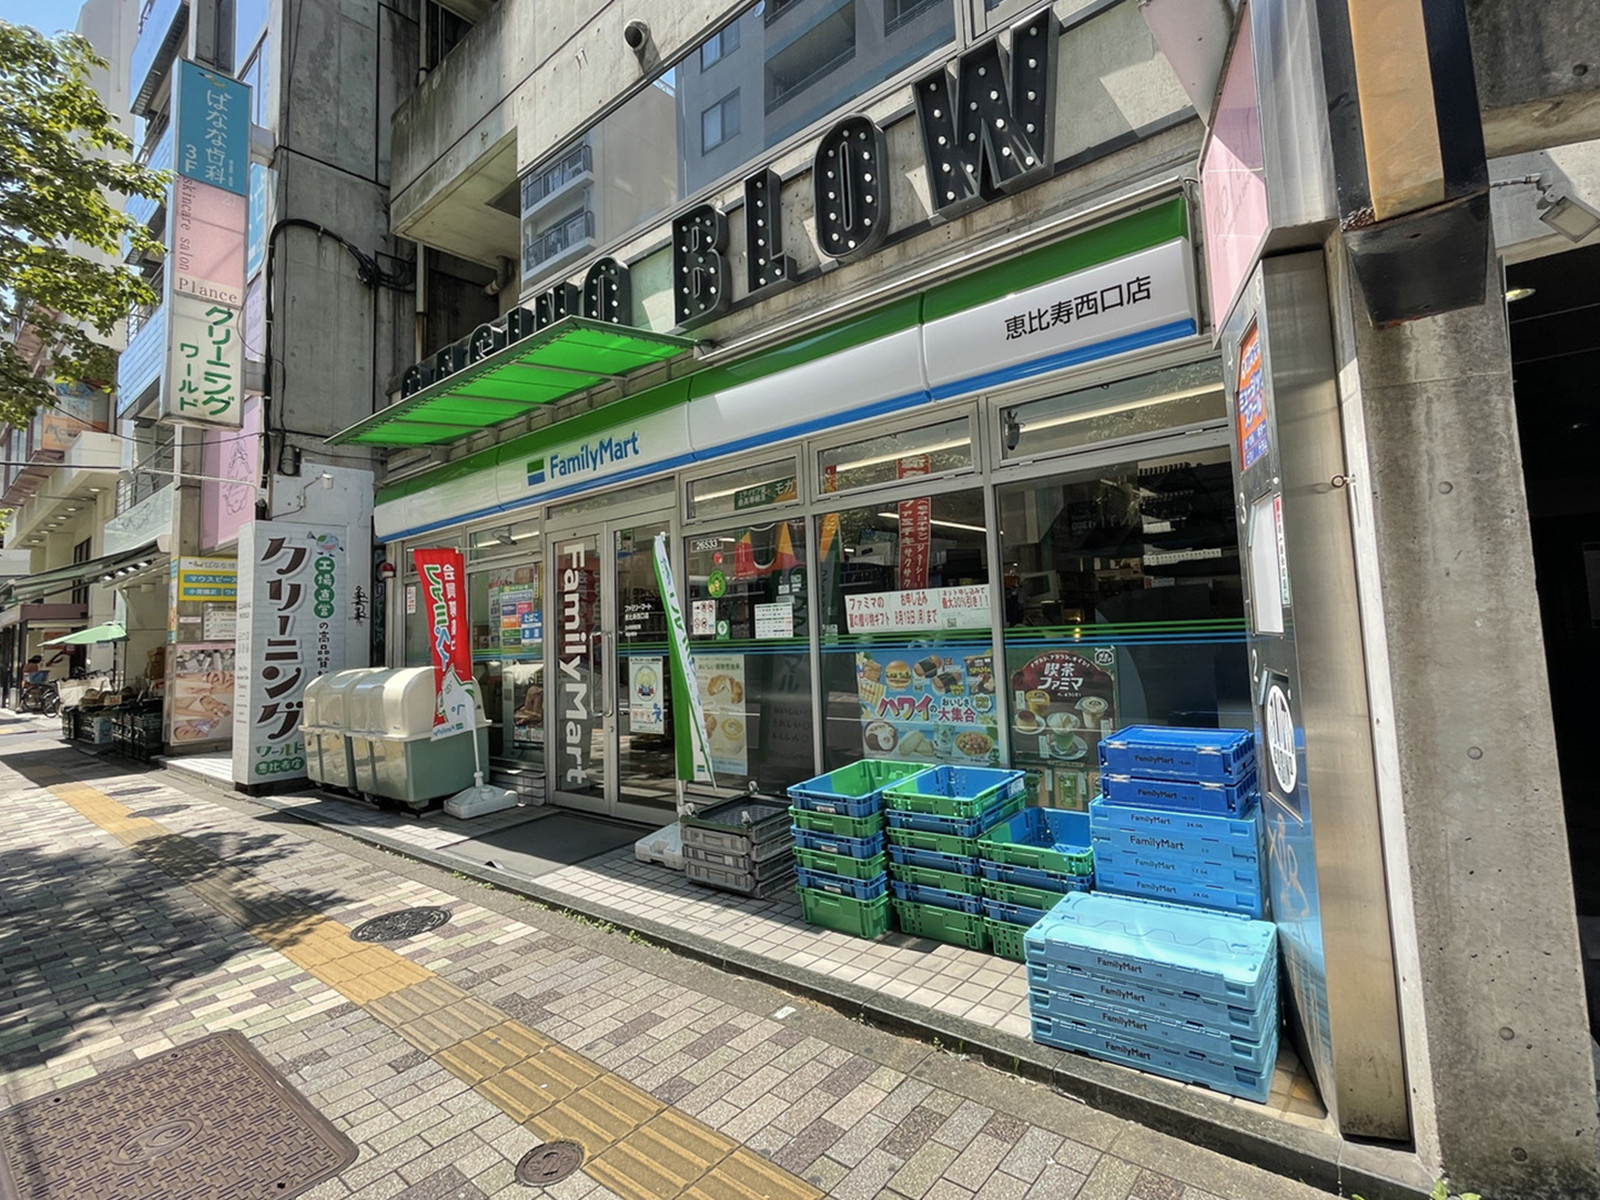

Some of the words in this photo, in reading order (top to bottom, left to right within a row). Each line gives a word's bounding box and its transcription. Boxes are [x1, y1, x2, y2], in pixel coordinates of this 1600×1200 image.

[204, 89, 232, 185] ばなな歯科
[185, 144, 198, 173] 3F
[672, 5, 1060, 330] BLOW
[180, 177, 198, 231] skincare
[178, 236, 194, 271] salon
[178, 277, 239, 304] Plance
[1004, 275, 1152, 341] 恵比寿西口店
[201, 306, 235, 416] クリーニング
[178, 342, 200, 412] ワールド
[550, 431, 640, 479] FamilyMart
[849, 596, 884, 611] ファミマの
[257, 536, 309, 741] クリーニング
[559, 543, 588, 784] FamilyMart
[1044, 662, 1076, 677] 喫茶
[1037, 676, 1084, 691] ファミマ
[876, 694, 938, 721] ハワイの
[942, 698, 971, 707] おいしさ
[938, 707, 976, 723] 大集合
[1134, 754, 1174, 764] FamilyMart
[1137, 788, 1177, 799] FamilyMart
[1131, 813, 1171, 825] FamilyMart
[1130, 835, 1185, 850] FamilyMart
[1134, 858, 1176, 871] FamilyMart
[1136, 881, 1177, 894] FamilyMart
[1097, 956, 1143, 974] FamilyMart
[1100, 985, 1146, 1003] FamilyMart
[1102, 1012, 1148, 1031] FamilyMart
[1105, 1041, 1151, 1060] FamilyMart
